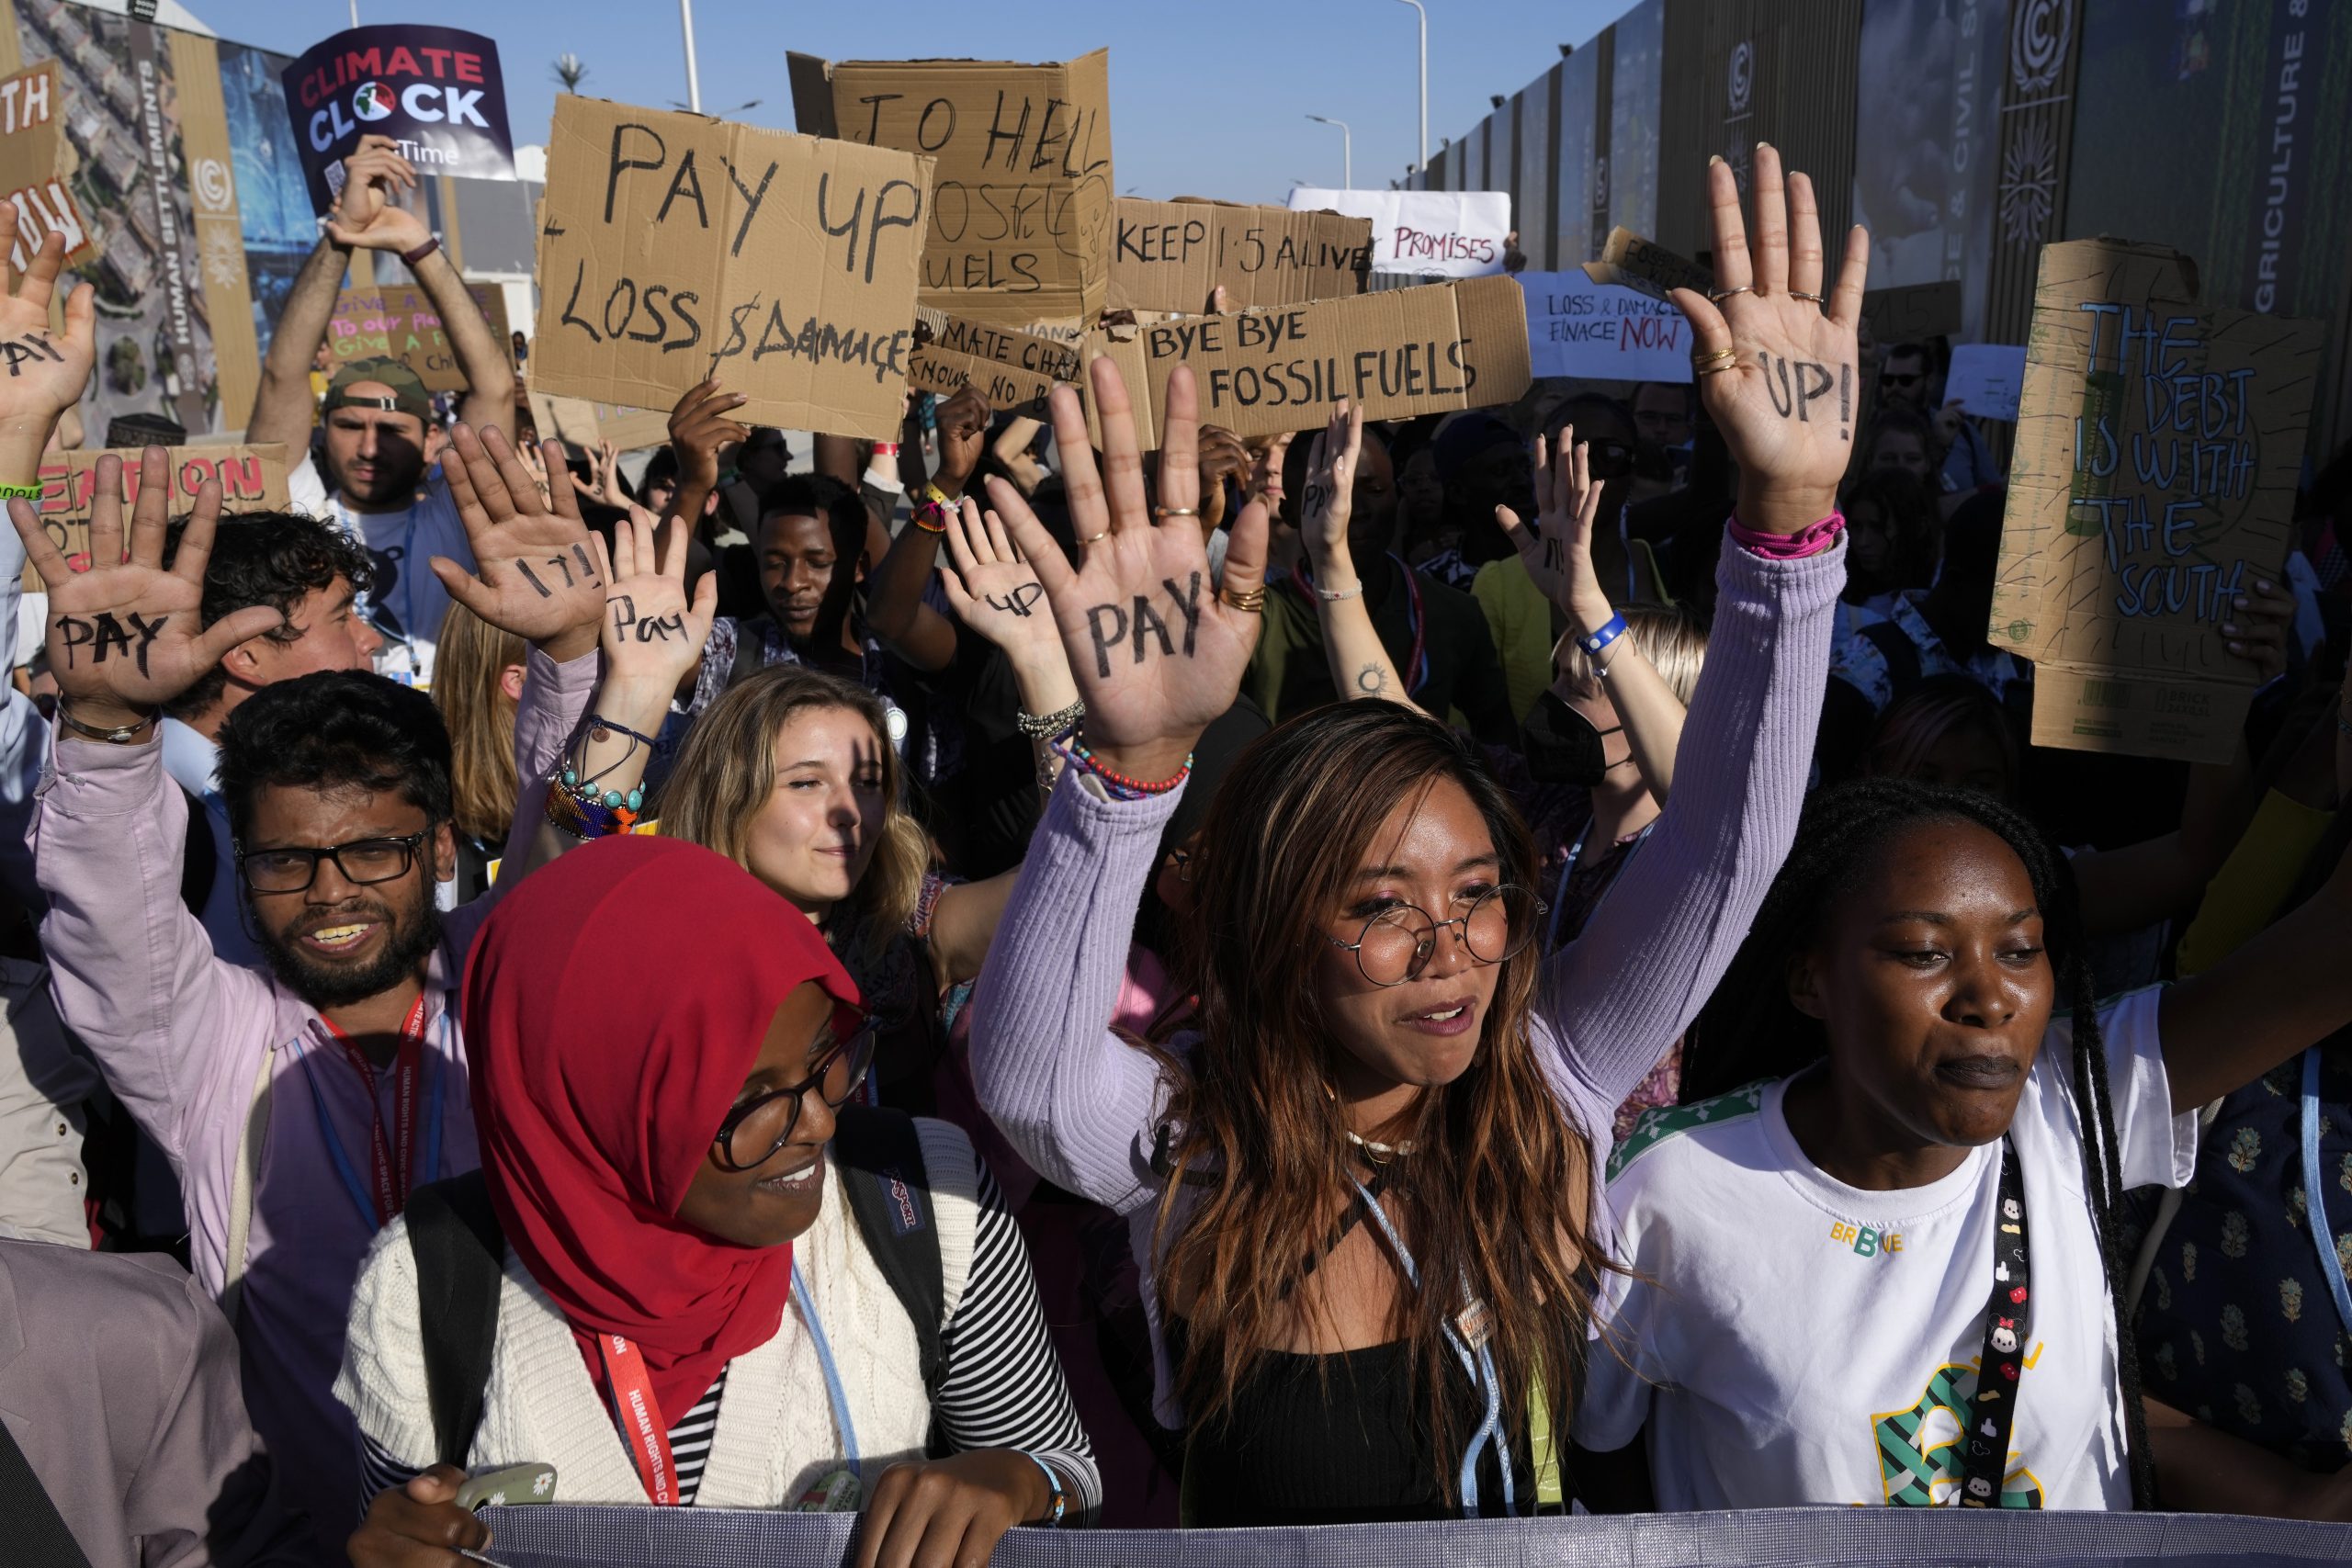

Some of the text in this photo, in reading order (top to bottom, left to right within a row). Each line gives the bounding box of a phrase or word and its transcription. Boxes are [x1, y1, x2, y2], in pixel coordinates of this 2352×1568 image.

[300, 46, 484, 108] CLIMATE
[982, 90, 1109, 178] HELL
[1952, 51, 1975, 173] CIVIL
[139, 61, 176, 245] SETTLEMENTS
[2254, 30, 2304, 313] GRICULTURE
[604, 123, 921, 284] PAY UP
[1116, 219, 1204, 263] KEEP
[1275, 235, 1372, 273] ALIVE
[165, 251, 189, 344] HUMAN
[561, 258, 699, 354] LOSS
[1547, 294, 1594, 316] LOSS
[0, 331, 65, 378] AY
[1149, 310, 1307, 359] BYE BYE
[1549, 316, 1681, 352] FINACE NOW
[2079, 302, 2200, 378] THE
[989, 375, 1015, 403] NO
[1210, 339, 1477, 408] FOSSIL FUELS
[1759, 351, 1851, 442] UP!
[2145, 369, 2256, 440] DEBT
[2075, 416, 2118, 478] IS
[2133, 433, 2256, 501] WITH
[2073, 498, 2205, 572] THE
[515, 543, 602, 598] IT!
[2115, 560, 2245, 623] SOUTH
[56, 612, 168, 680] PAY
[606, 594, 689, 642] Pay
[1086, 570, 1202, 679] PAY
[401, 1097, 411, 1128] RIGHTS
[402, 1066, 412, 1097] HUMAN
[376, 1143, 386, 1165] CIVIC
[399, 1147, 408, 1172] CIVIC
[400, 1129, 409, 1147] AND
[379, 1164, 390, 1194] SPACE
[383, 1194, 395, 1212] FOR
[612, 1334, 628, 1356] ON
[628, 1390, 670, 1507] HUMAN RIGHTS AND CI
